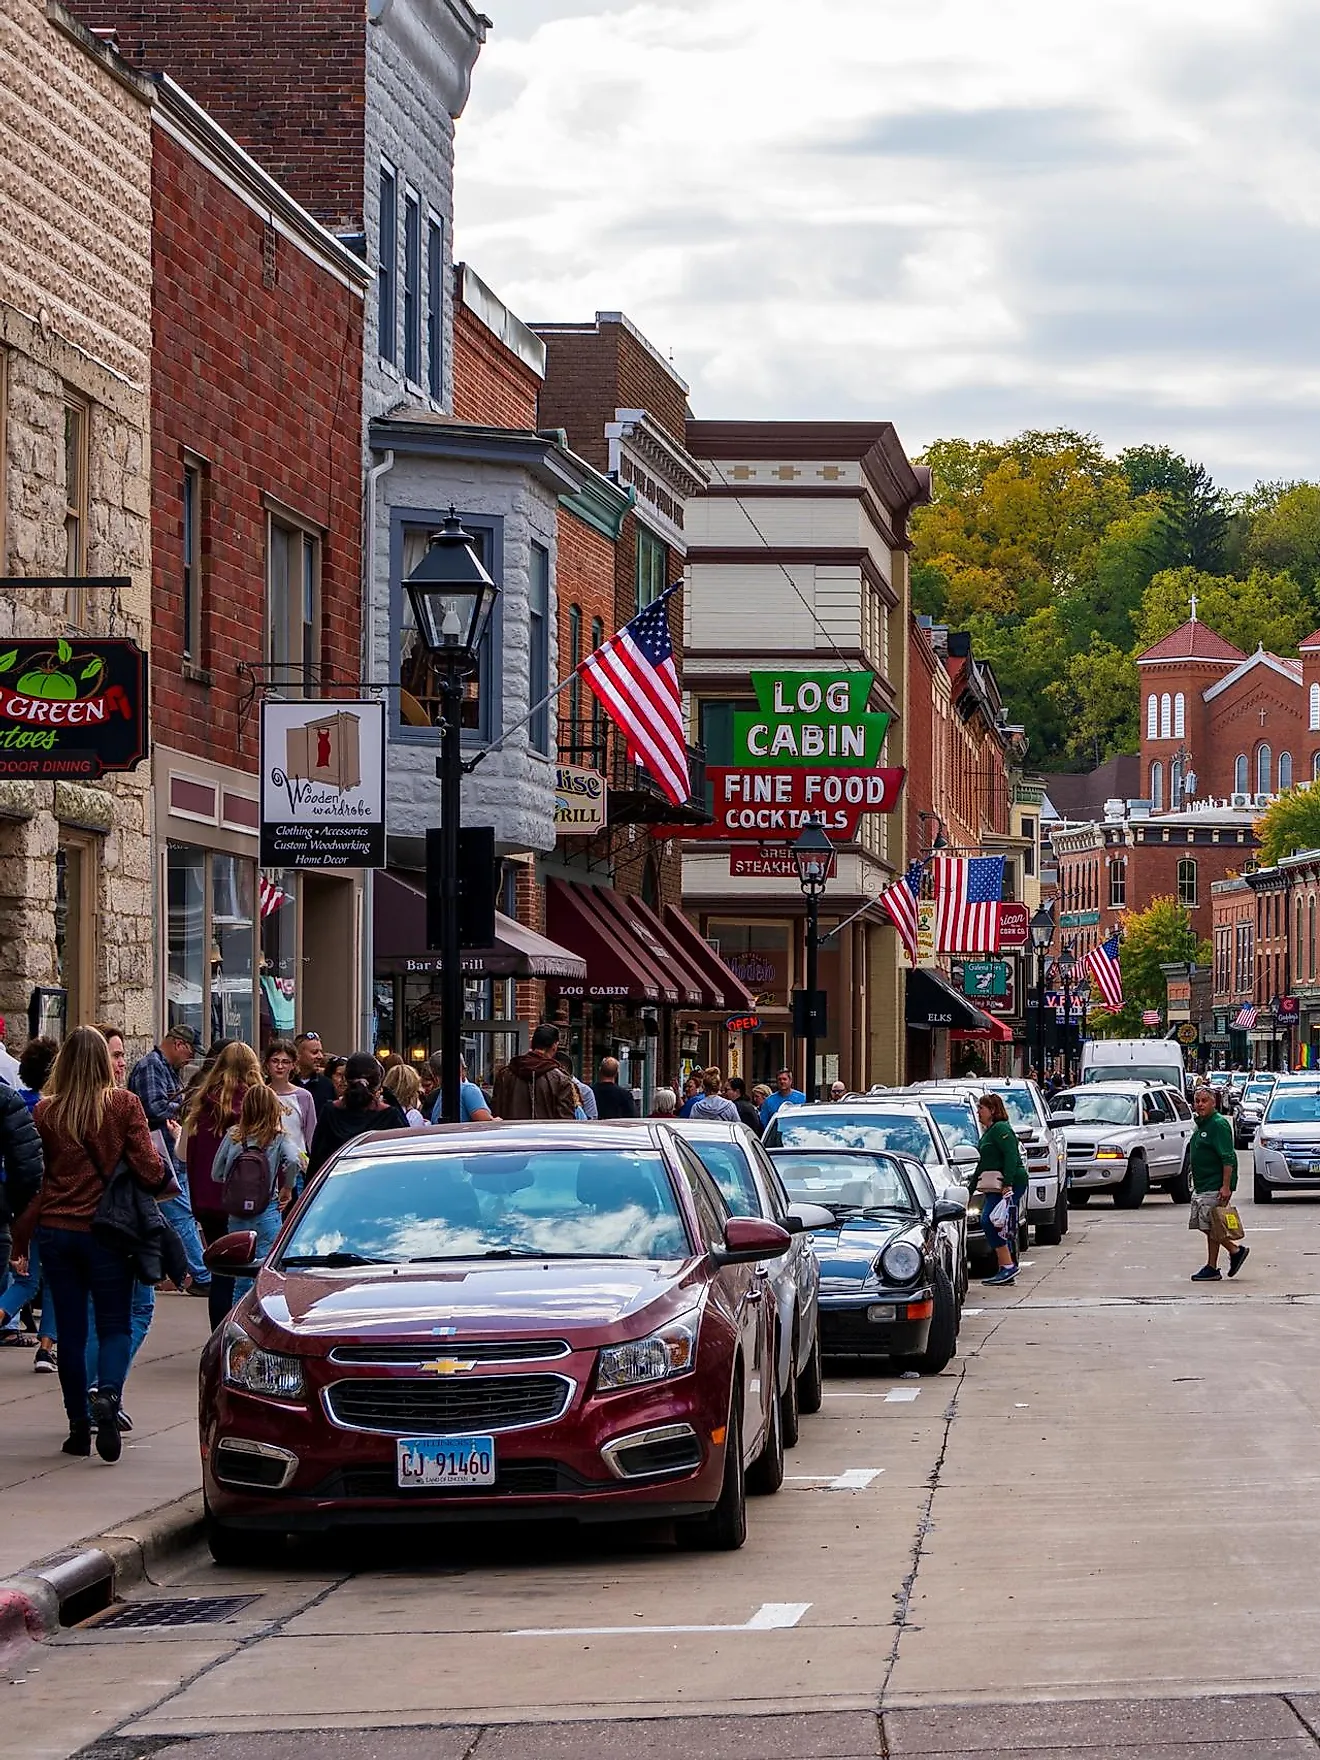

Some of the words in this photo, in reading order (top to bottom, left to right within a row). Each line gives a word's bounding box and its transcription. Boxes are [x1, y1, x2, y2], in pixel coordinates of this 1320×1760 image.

[774, 681, 849, 713] LOG
[6, 696, 104, 723] GREEN
[747, 724, 866, 757] CABIN
[42, 761, 91, 773] DINING
[271, 768, 340, 815] Wooden
[724, 774, 793, 803] FINE
[804, 775, 886, 805] FOOD
[312, 800, 372, 816] wardrobe
[725, 809, 848, 829] COCKTALS
[275, 826, 313, 840] Clothing
[320, 826, 369, 836] Accessories
[273, 840, 307, 850] Custom
[310, 840, 371, 855] Woodworking
[295, 854, 321, 864] Home
[323, 854, 350, 864] Decor
[406, 959, 432, 970] Bar
[462, 959, 484, 970] rill
[559, 986, 584, 995] LOG
[589, 986, 629, 995] CABIN
[728, 1016, 759, 1031] OPEN
[927, 1013, 952, 1022] ELKS
[401, 1453, 425, 1477] CJ
[435, 1452, 491, 1477] 91460
